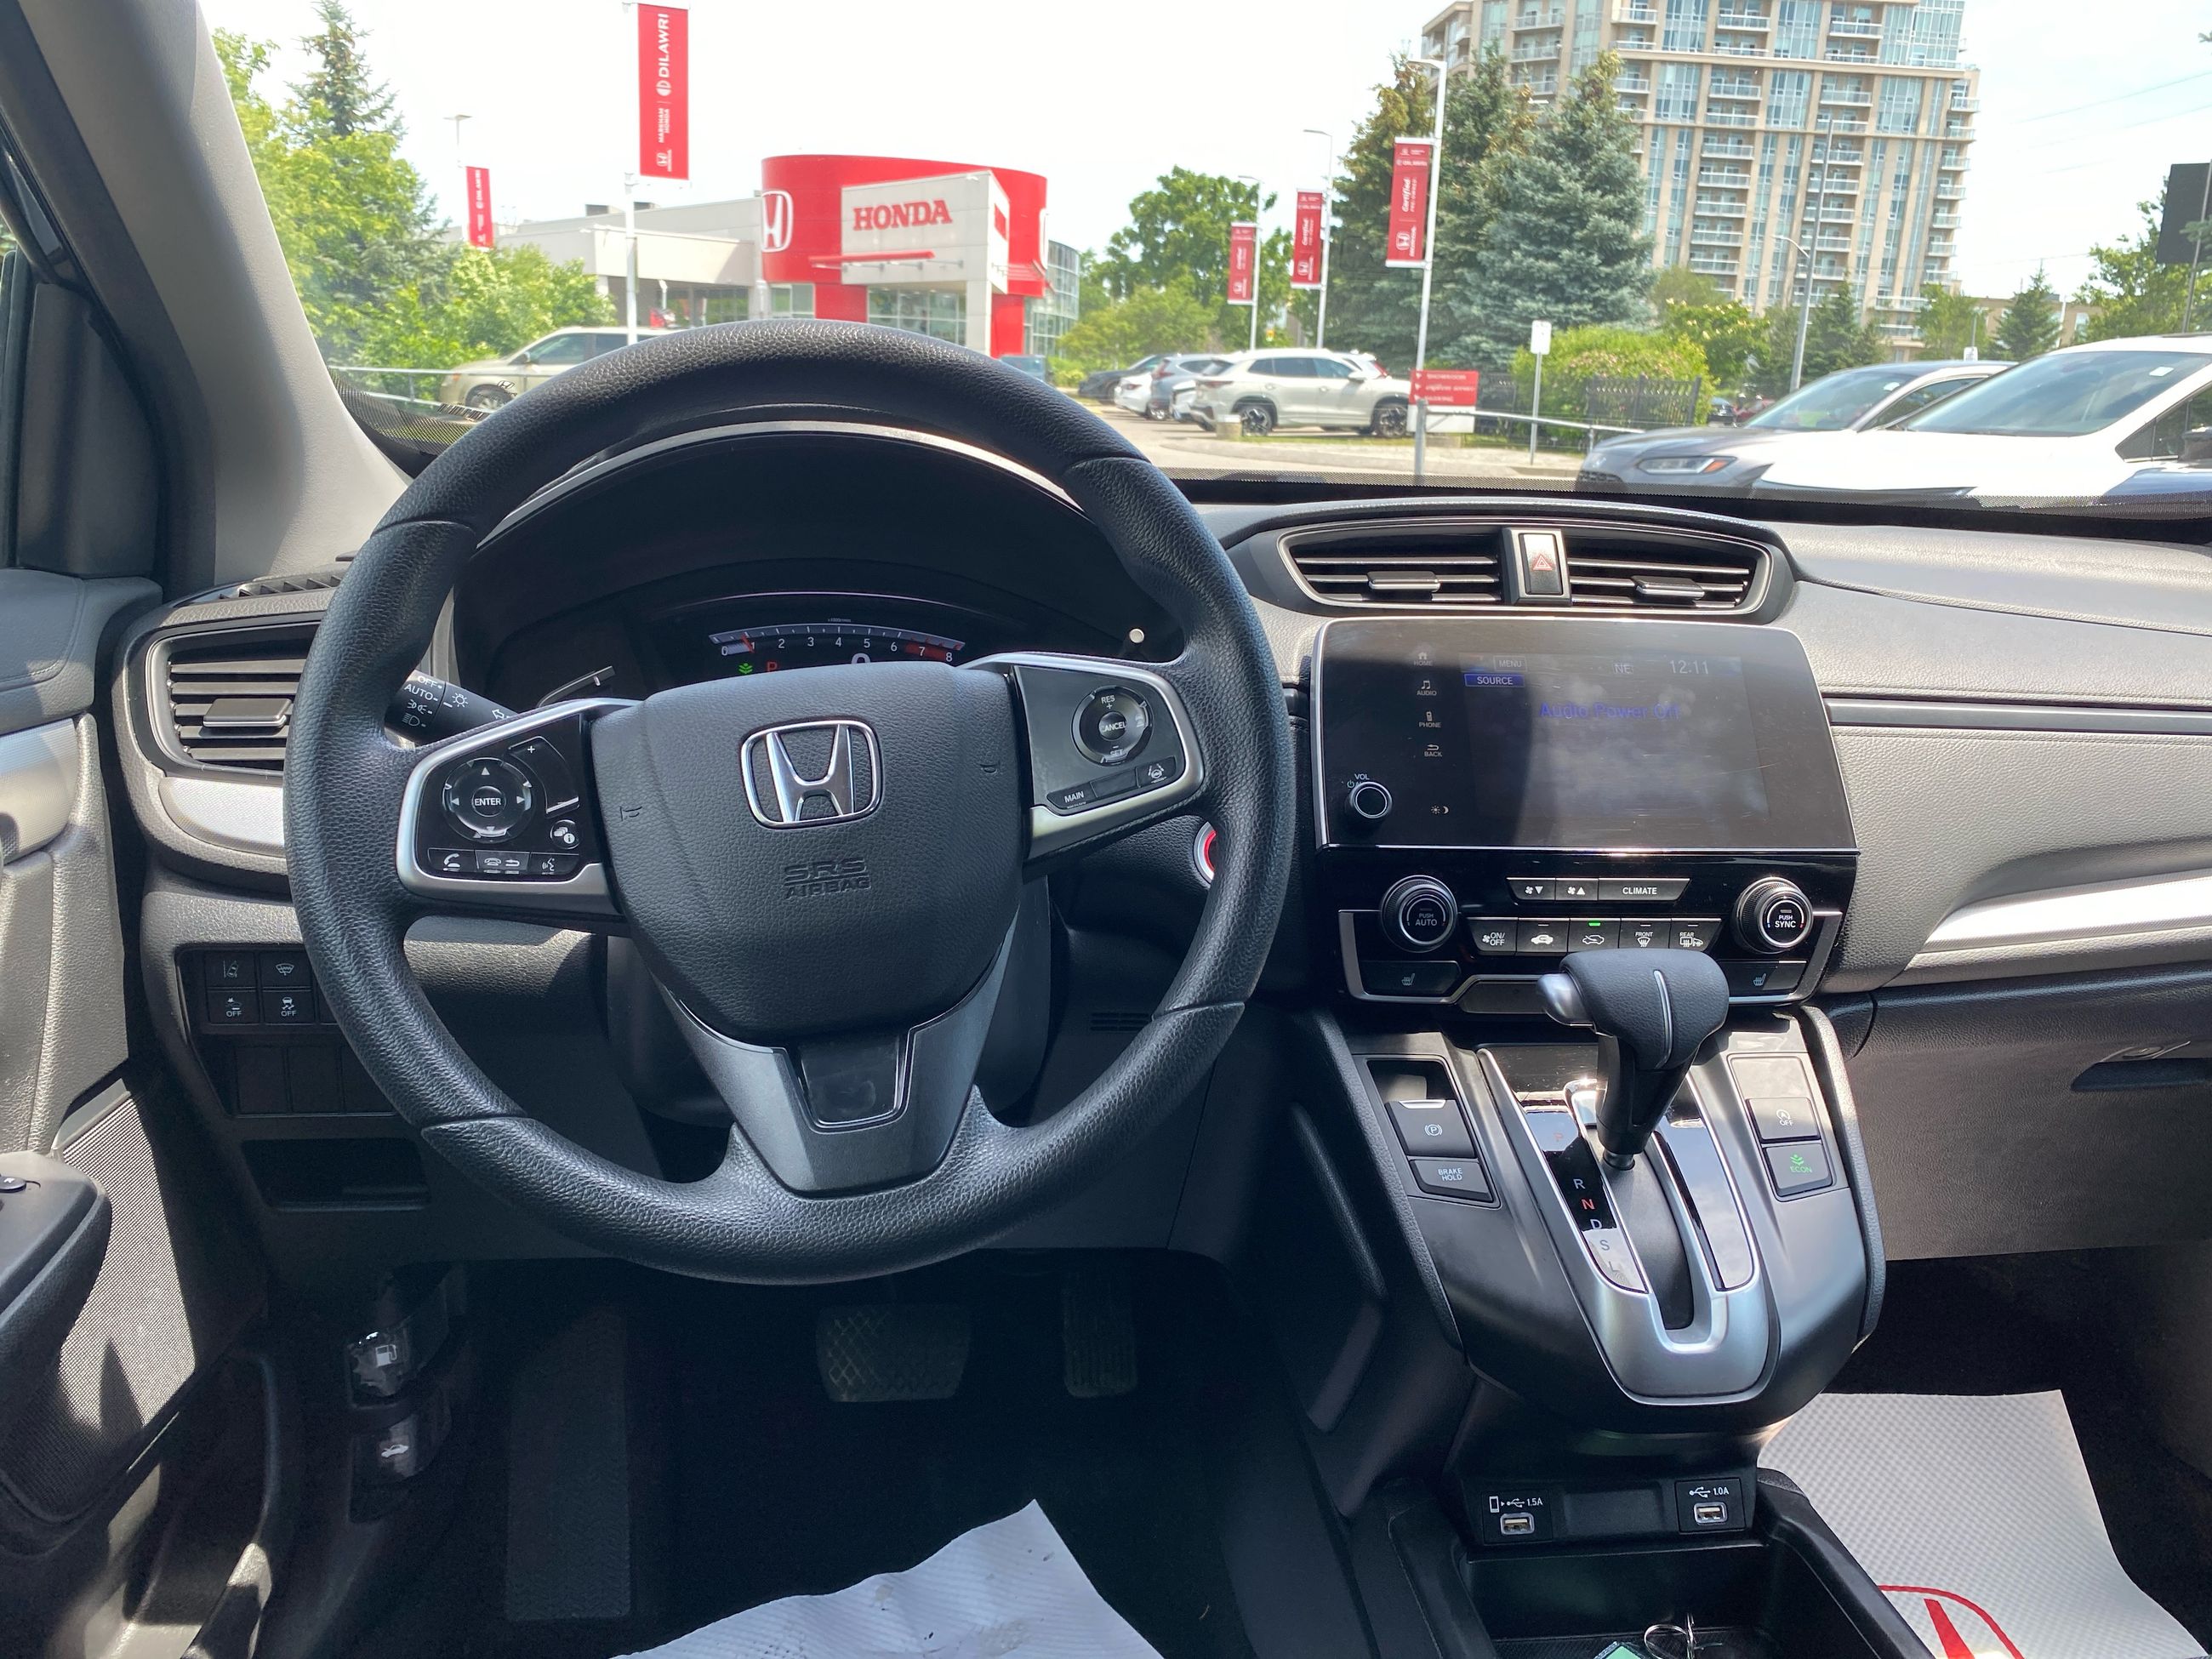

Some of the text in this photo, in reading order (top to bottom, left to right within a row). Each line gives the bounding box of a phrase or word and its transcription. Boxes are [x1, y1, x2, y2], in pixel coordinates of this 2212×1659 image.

[658, 13, 670, 78] DILAWRI
[1401, 176, 1411, 213] Certified
[852, 200, 953, 231] HONDA
[721, 637, 953, 663] 0 1 2 3 4 5 6 7 8
[767, 661, 778, 672] P
[1498, 659, 1522, 668] MENU
[1669, 659, 1709, 675] 12:11
[418, 675, 437, 688] OFF
[1476, 676, 1514, 686] SOURCE
[404, 683, 434, 701] AUTO
[1101, 694, 1115, 704] RES
[1539, 702, 1680, 720] Audio Power Off
[1099, 721, 1127, 733] CANCEL
[1110, 749, 1123, 757] SET
[474, 797, 502, 807] ENTER
[1064, 790, 1085, 803] MAIN
[783, 858, 867, 884] SRS
[784, 875, 872, 901] AIRBAG
[1622, 887, 1657, 896] CLIMATE
[1438, 1167, 1463, 1176] BRAKE
[1573, 1178, 1586, 1189] R
[1581, 1198, 1595, 1210] N
[1590, 1218, 1603, 1229] D
[1599, 1239, 1611, 1251] S
[1713, 1486, 1730, 1496] 1.0A
[1526, 1497, 1543, 1507] 1.5A
